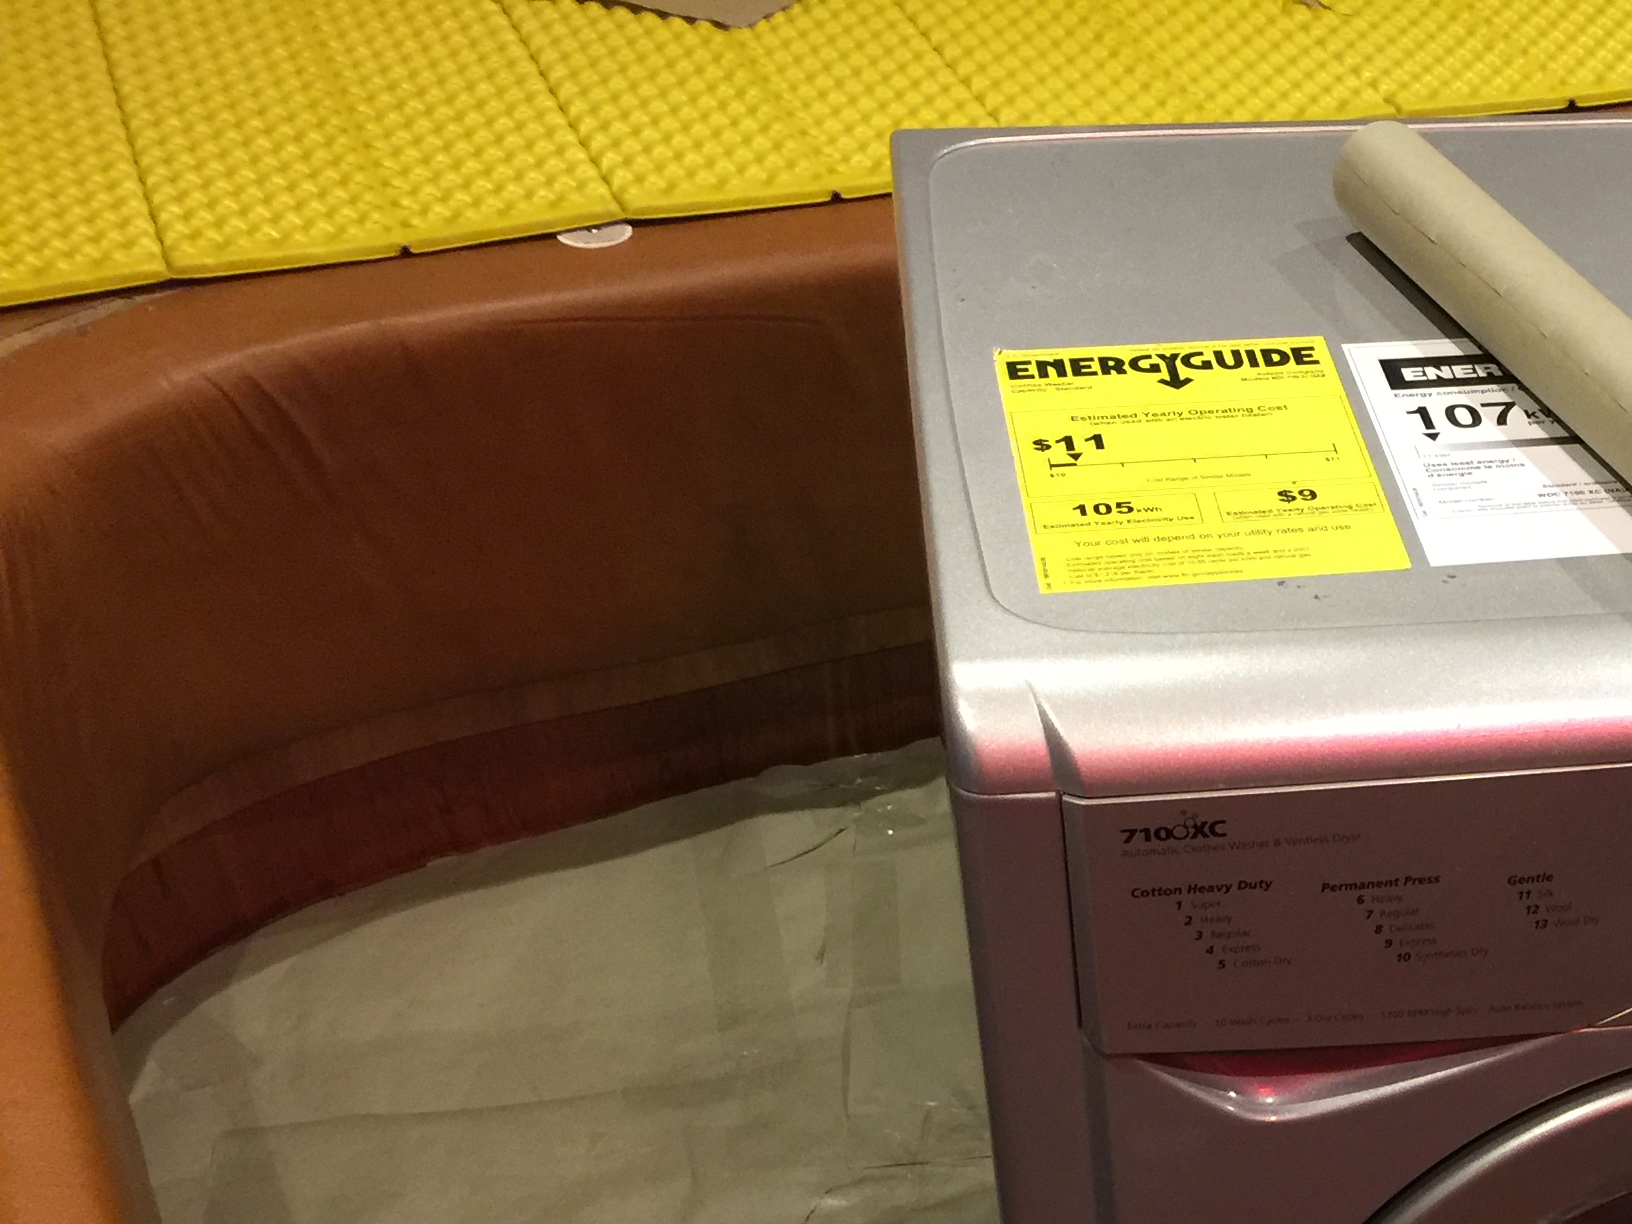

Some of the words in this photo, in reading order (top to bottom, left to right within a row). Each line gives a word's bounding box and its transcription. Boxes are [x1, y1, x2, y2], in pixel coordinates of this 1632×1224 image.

[1005, 346, 1321, 389] ENERGYGUIDE
[1393, 391, 1433, 399] Energy
[1071, 412, 1138, 422] Estimated
[1141, 409, 1184, 419] Yearly
[1187, 405, 1254, 417] Operating
[1257, 404, 1289, 412] Cost
[1406, 401, 1517, 430] 107
[1032, 433, 1105, 452] $11
[1276, 489, 1318, 504] $9
[1072, 501, 1135, 516] 105
[1135, 505, 1163, 513] kWh
[1074, 540, 1101, 548] Your
[1105, 537, 1129, 545] cost
[1131, 535, 1150, 544] will
[1153, 533, 1196, 543] depend
[1199, 532, 1214, 540] on
[1217, 531, 1241, 540] your
[1307, 524, 1328, 532] and
[1120, 846, 1181, 857] Automatic
[1183, 843, 1226, 854] Clothes
[1228, 838, 1270, 850] Washer
[1332, 832, 1362, 845] Dryer
[1320, 876, 1401, 893] Permanent
[1403, 874, 1442, 887] Press
[1507, 872, 1554, 886] Gentle
[1130, 886, 1183, 898] Cotton
[1187, 882, 1233, 895] Heavy
[1237, 878, 1273, 891] Duty
[1356, 894, 1366, 905] 6
[1518, 890, 1532, 901] 11
[1175, 900, 1183, 911] 1
[1525, 904, 1540, 915] 12
[1544, 902, 1573, 913] Wool
[1183, 915, 1193, 926] 2
[1366, 909, 1374, 920] 7
[1379, 908, 1420, 920] Regular
[1373, 924, 1384, 935] 8
[1534, 918, 1549, 930] 13
[1554, 916, 1580, 928] Wool
[1583, 915, 1600, 926] Dry
[1194, 930, 1203, 941] 3
[1210, 928, 1251, 940] Regular
[1205, 945, 1215, 955] 4
[1221, 944, 1262, 955] Express
[1383, 938, 1393, 949] 9
[1396, 951, 1412, 963] 10
[1470, 946, 1489, 957] Dry
[1217, 959, 1226, 970] 5
[1232, 958, 1271, 969] Cotton
[1273, 955, 1293, 966] Dry
[1127, 1021, 1152, 1031] Extra
